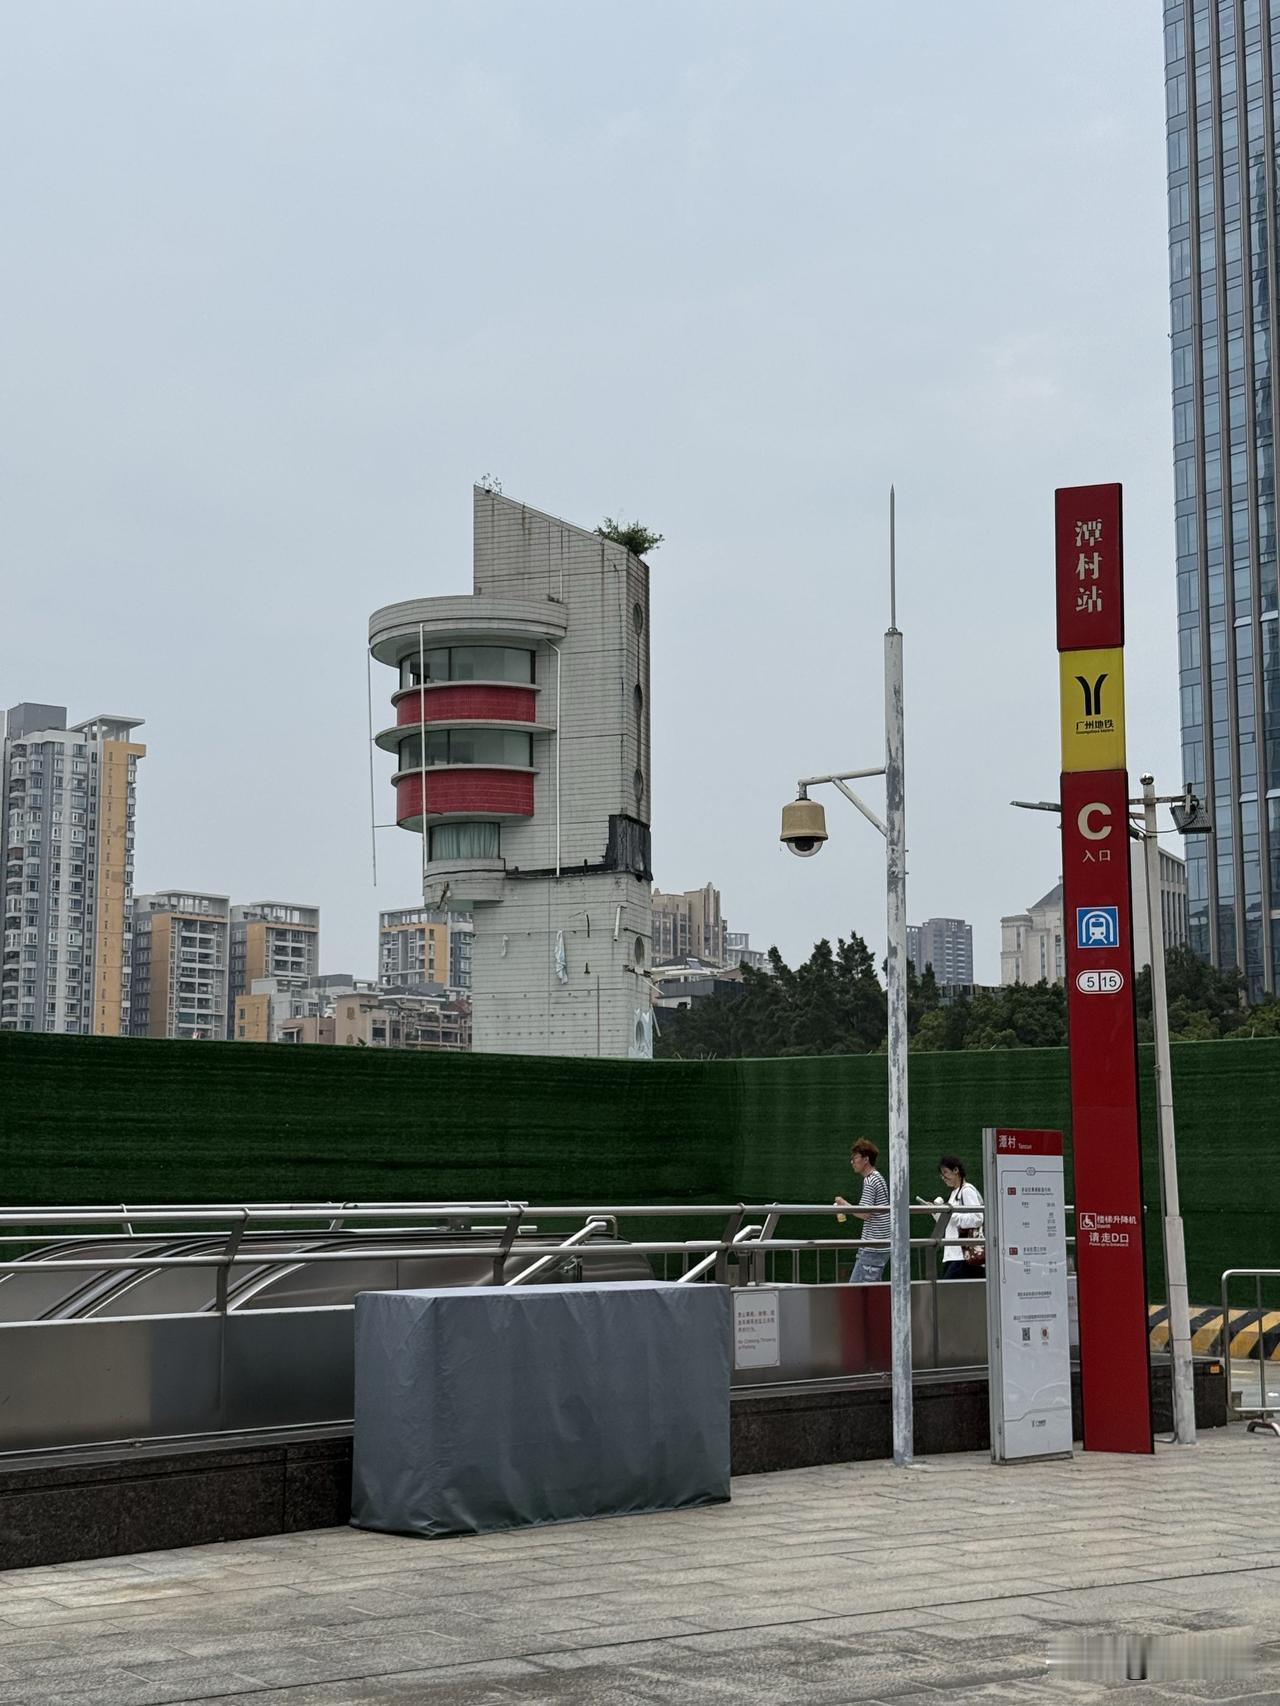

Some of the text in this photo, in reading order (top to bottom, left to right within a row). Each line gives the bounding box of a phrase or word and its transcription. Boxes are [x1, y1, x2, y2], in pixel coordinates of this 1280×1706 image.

[1075, 518, 1103, 613] 潭村站
[1076, 719, 1114, 731] 广州地铁
[1077, 802, 1112, 841] C
[1082, 849, 1111, 863] 入口
[1086, 976, 1117, 989] 5 15
[1089, 1231, 1129, 1243] 请走D口
